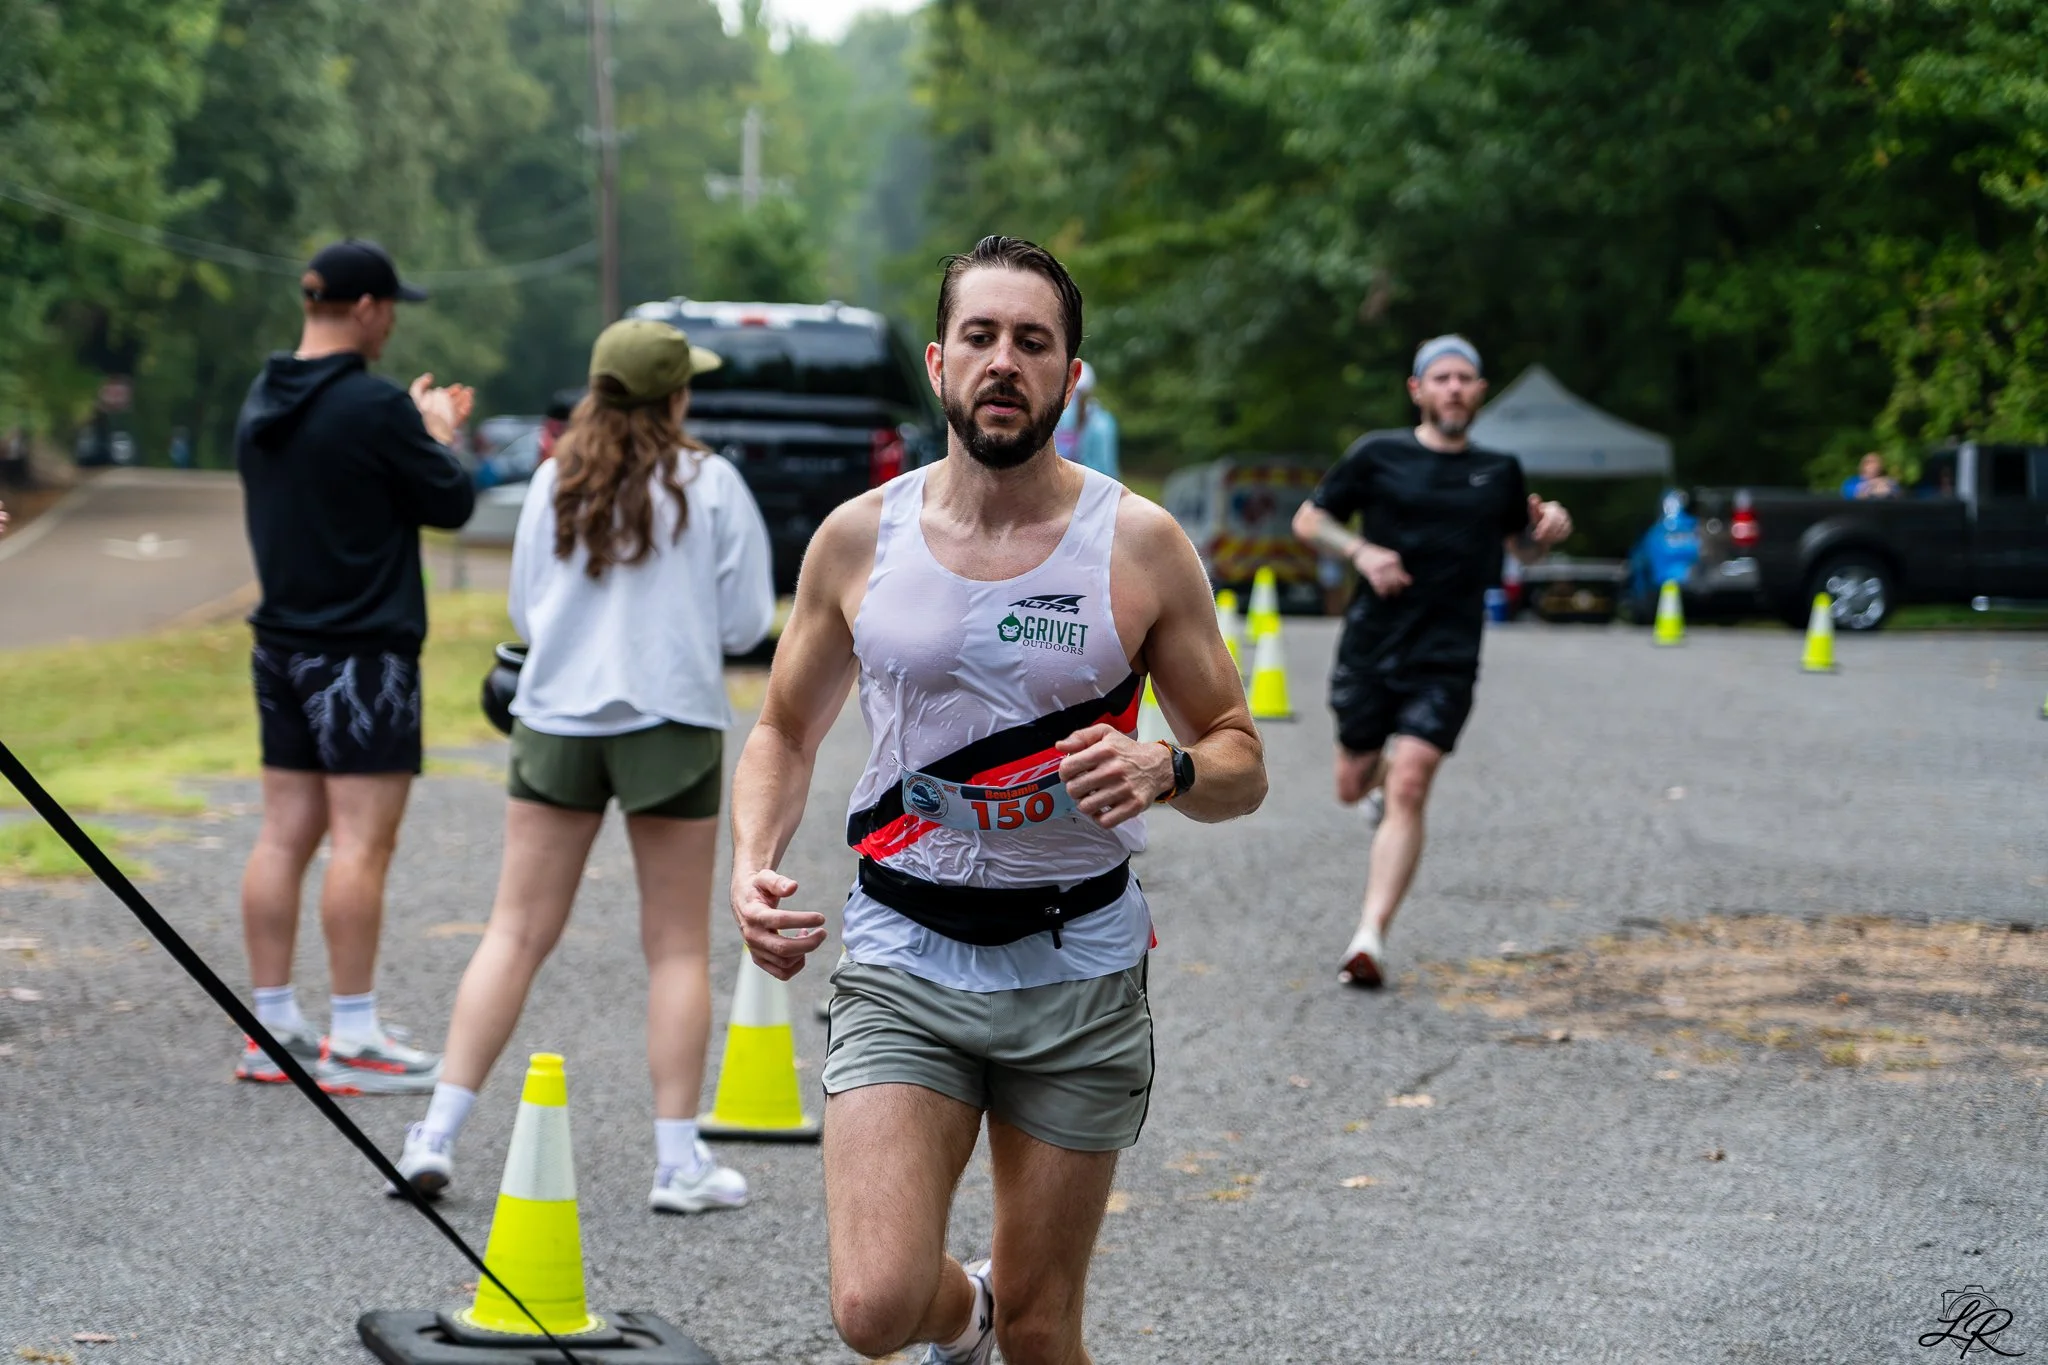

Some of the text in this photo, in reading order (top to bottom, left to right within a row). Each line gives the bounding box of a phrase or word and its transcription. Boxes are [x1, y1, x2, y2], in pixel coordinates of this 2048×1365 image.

[1008, 599, 1081, 615] ALTRA
[1023, 615, 1089, 648] GRIVET
[1022, 639, 1085, 656] OUTDOORS
[984, 783, 1039, 800] Benjamin
[970, 791, 1055, 831] 150
